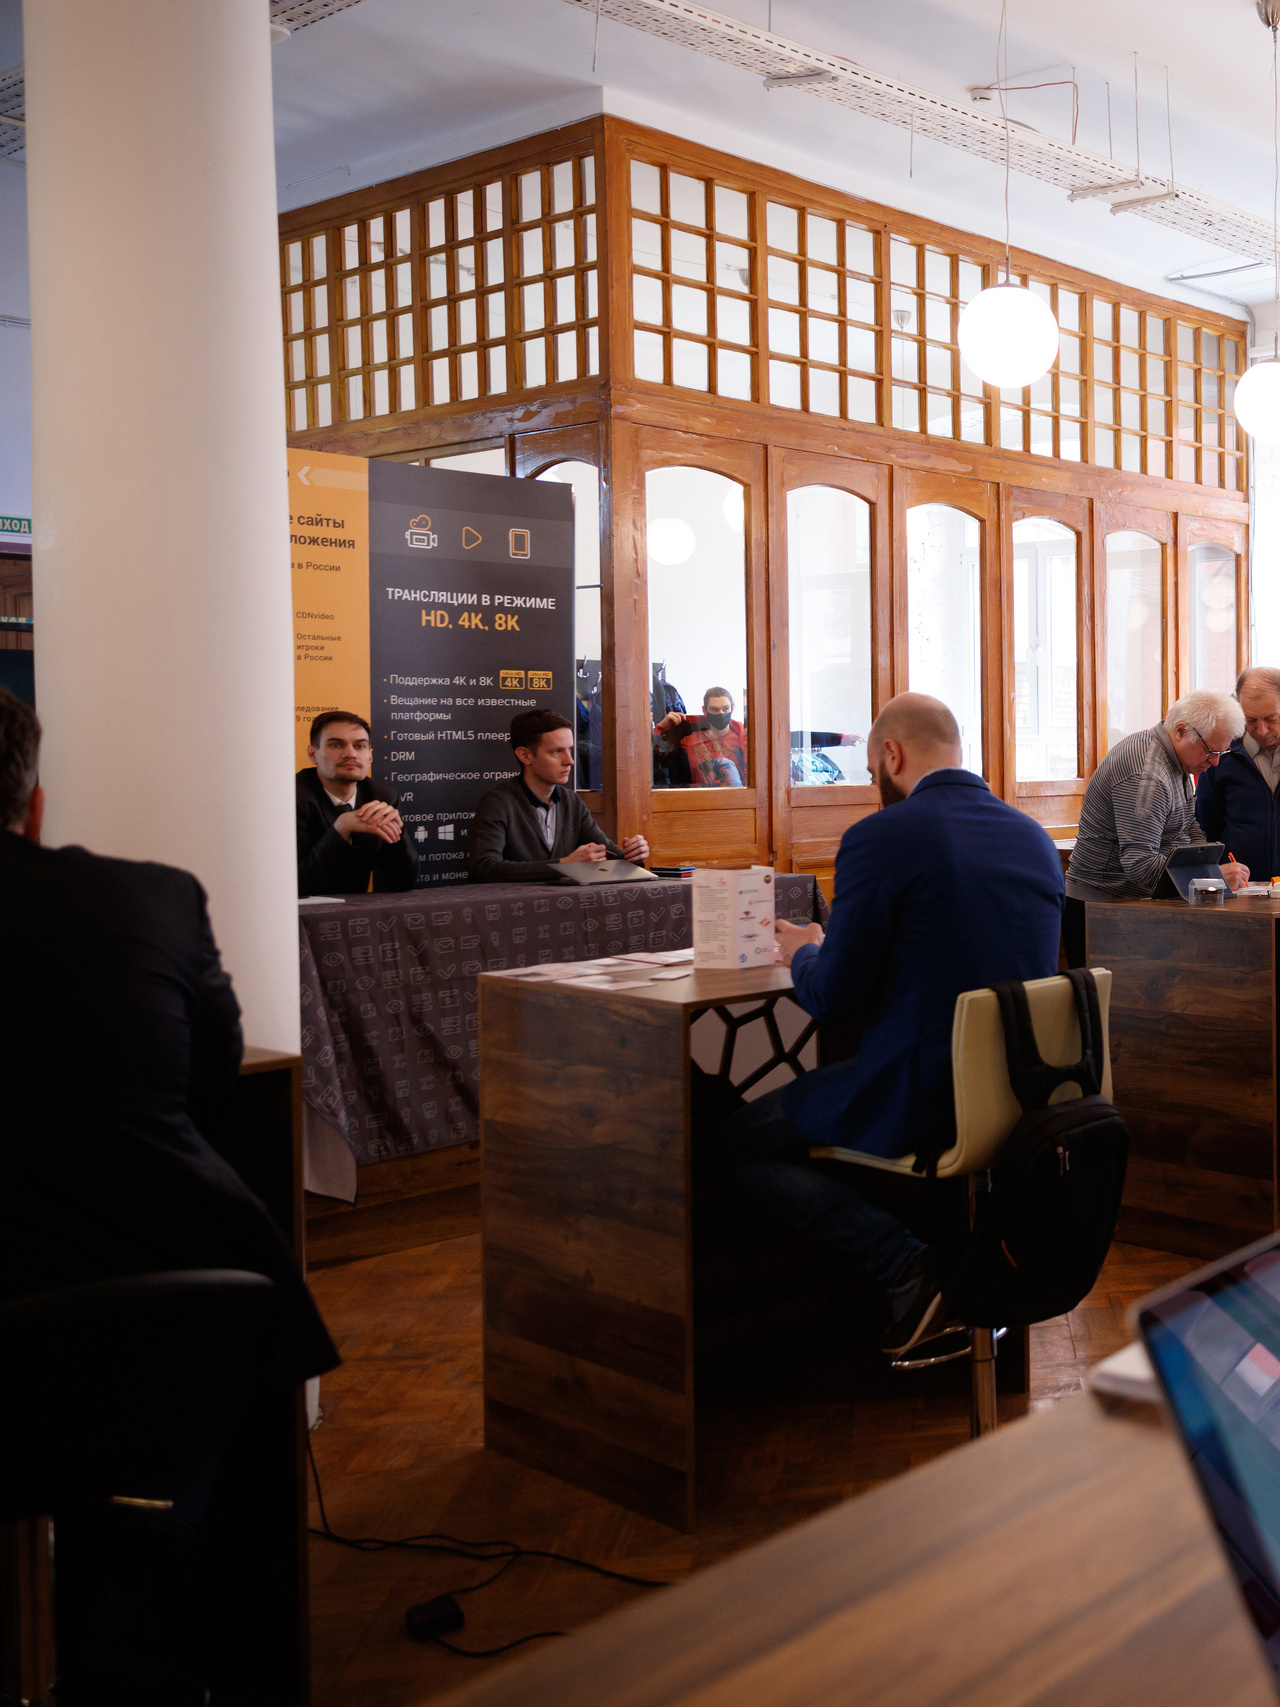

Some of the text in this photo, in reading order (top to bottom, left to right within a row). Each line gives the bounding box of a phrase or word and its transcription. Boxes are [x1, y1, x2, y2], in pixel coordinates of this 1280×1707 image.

[297, 513, 345, 529] сайты
[290, 534, 356, 549] ложения
[297, 562, 304, 570] в
[306, 561, 341, 572] России
[386, 587, 557, 610] ТРАНСЛЯЦИИ В РЕЖИМЕ
[295, 611, 335, 621] CDNvideo
[421, 609, 521, 632] HD, 4K, 8K
[296, 632, 342, 642] Остальные
[296, 644, 325, 652] игроки
[304, 653, 333, 662] России
[390, 674, 450, 686] Поддержка
[452, 676, 467, 685] 4К
[479, 676, 494, 686] 8К
[504, 677, 520, 688] 4K
[532, 678, 548, 688] 8K
[390, 695, 537, 707] Вещание на все известные
[294, 705, 340, 713] ледование
[390, 711, 452, 722] платформы
[390, 730, 511, 742] Готовый HTML5 плеер
[390, 751, 415, 762] DRM
[390, 771, 481, 783] Географическое
[429, 851, 464, 861] потока
[432, 873, 439, 881] и
